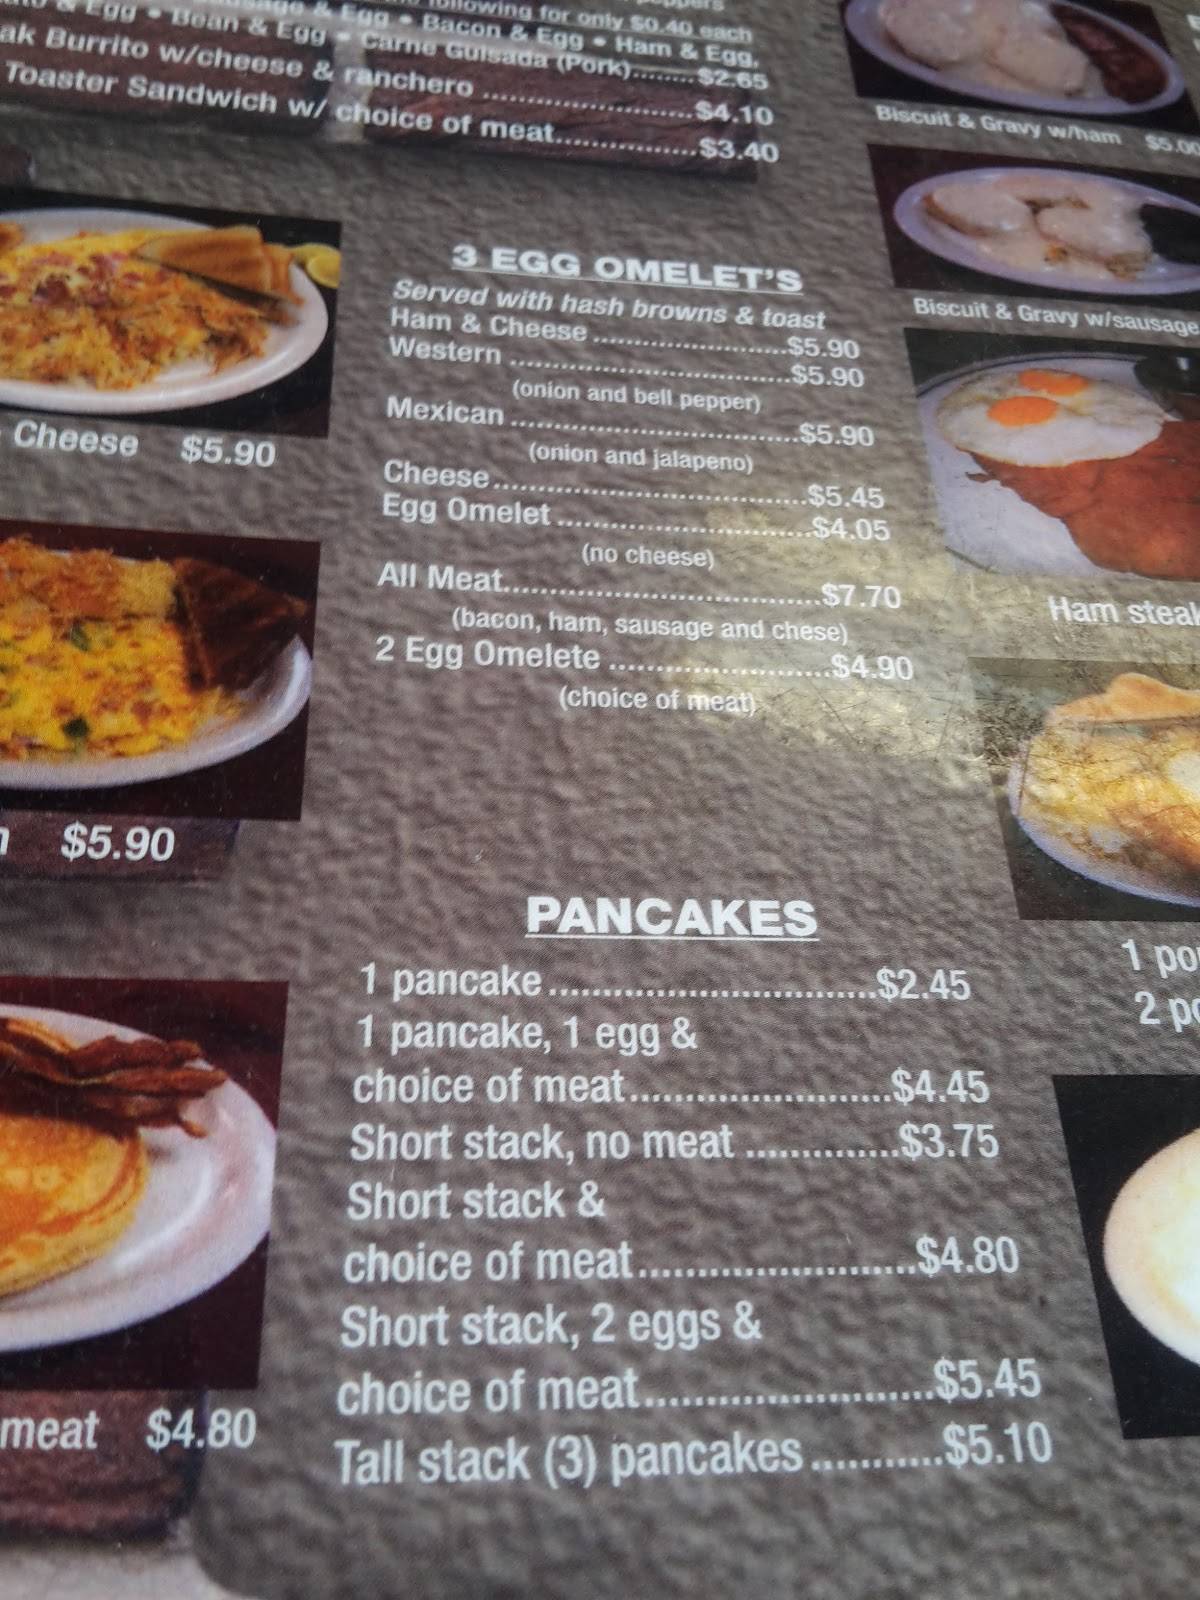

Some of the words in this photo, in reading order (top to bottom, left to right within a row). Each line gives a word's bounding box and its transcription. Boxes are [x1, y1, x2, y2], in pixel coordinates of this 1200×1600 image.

[86, 0, 137, 23] Egg
[171, 7, 239, 33] Bean
[248, 15, 268, 36] &
[276, 20, 326, 47] Egg
[361, 31, 436, 57] Carne
[445, 43, 549, 69] Guisada
[556, 54, 632, 81] (Pork)
[697, 67, 769, 91] $2.65
[341, 3, 389, 28] Egg
[422, 14, 502, 39] Bacon
[509, 25, 533, 43] &
[536, 26, 584, 52] Egg
[615, 35, 672, 58] Ham
[679, 43, 698, 61] &
[540, 3, 572, 24] for
[578, 10, 624, 31] only
[630, 14, 693, 36] $0.40
[699, 25, 753, 43] each
[46, 26, 149, 59] Burrito
[159, 43, 304, 78] w/cheese
[313, 60, 333, 81] &
[343, 66, 474, 99] ranchero
[695, 100, 774, 126] $4.10
[6, 60, 118, 95] Toaster
[127, 74, 278, 114] Sandwich
[287, 97, 329, 119] w/
[335, 101, 433, 131] choice
[442, 113, 471, 136] of
[480, 119, 555, 145] meat
[698, 137, 780, 164] $3.40
[875, 104, 951, 128] Biscuit
[957, 112, 976, 129] &
[979, 114, 1042, 141] Gravy
[1047, 122, 1122, 145] w/ham
[451, 243, 478, 268] 3
[491, 246, 581, 277] EGG
[594, 256, 803, 293] OMELET'S
[392, 278, 489, 306] Served
[496, 289, 554, 312] with
[560, 293, 624, 318] hash
[631, 299, 728, 324] browns
[734, 305, 755, 325] &
[762, 308, 827, 330] toast
[913, 297, 989, 319] Biscuit
[995, 303, 1013, 321] &
[1017, 305, 1078, 328] Gravy
[1084, 311, 1200, 337] w/sausage
[390, 306, 452, 331] Ham
[460, 312, 481, 334] &
[489, 315, 588, 342] Cheese
[787, 335, 861, 360] $5.90
[388, 335, 502, 365] Western
[790, 363, 865, 388] $5.90
[512, 378, 580, 400] (onion
[587, 385, 627, 403] and
[634, 387, 672, 406] bell
[679, 391, 761, 414] pepper)
[14, 418, 139, 458] Cheese
[180, 433, 276, 468] $5.90
[386, 395, 505, 426] Mexican
[799, 421, 875, 447] $5.90
[528, 441, 598, 463] (onion
[605, 447, 646, 466] and
[652, 448, 754, 474] jalapeno)
[383, 458, 490, 489] Cheese
[807, 483, 885, 509] $5.45
[382, 492, 437, 524] Egg
[447, 496, 551, 526] Omelet
[812, 515, 891, 541] $4.05
[581, 542, 618, 566] (no
[625, 545, 715, 572] cheese)
[377, 561, 417, 588] All
[427, 564, 503, 593] Meat
[821, 582, 902, 609] $7.70
[452, 606, 542, 633] (bacon,
[548, 610, 608, 637] ham,
[614, 618, 714, 641] sausage
[721, 620, 765, 640] and
[771, 621, 849, 646] chese)
[1047, 596, 1120, 623] Ham
[375, 635, 395, 662] 2
[405, 636, 464, 670] Egg
[474, 639, 601, 670] Omelete
[831, 653, 914, 681] $4.90
[559, 684, 648, 711] (choice
[655, 690, 679, 710] of
[687, 691, 757, 717] meat)
[61, 819, 175, 862] $5.90
[526, 895, 818, 937] PANCAKES
[1121, 938, 1141, 971] 1
[1154, 945, 1200, 979] po
[360, 961, 376, 995] 1
[393, 963, 543, 1003] pancake
[876, 965, 972, 1003] $2.45
[1134, 991, 1160, 1025] 2
[357, 1013, 374, 1048] 1
[391, 1014, 551, 1056] pancake,
[563, 1015, 580, 1049] 1
[595, 1021, 661, 1057] egg
[671, 1016, 698, 1049] &
[352, 1066, 475, 1104] choice
[486, 1066, 523, 1104] of
[533, 1068, 626, 1103] meat
[891, 1066, 991, 1106] $4.45
[350, 1121, 453, 1162] Short
[463, 1122, 575, 1166] stack,
[585, 1127, 631, 1160] no
[643, 1123, 735, 1160] meat
[899, 1120, 1000, 1161] $3.75
[347, 1181, 451, 1221] Short
[462, 1180, 566, 1219] stack
[576, 1179, 606, 1218] &
[343, 1242, 473, 1284] choice
[484, 1239, 524, 1283] of
[536, 1240, 634, 1281] meat
[916, 1233, 1020, 1278] $4.80
[340, 1304, 450, 1348] Short
[461, 1303, 580, 1350] stack,
[591, 1302, 616, 1343] 2
[627, 1307, 721, 1351] eggs
[732, 1299, 763, 1341] &
[336, 1370, 472, 1416] choice
[484, 1367, 526, 1413] of
[538, 1367, 640, 1410] meat
[933, 1356, 1042, 1404] $5.45
[0, 1410, 100, 1450] meat
[146, 1407, 257, 1453] $4.80
[333, 1438, 404, 1485] Tall
[417, 1436, 531, 1484] stack
[544, 1433, 598, 1490] (3)
[611, 1430, 803, 1487] pancakes
[942, 1421, 1053, 1470] $5.10
